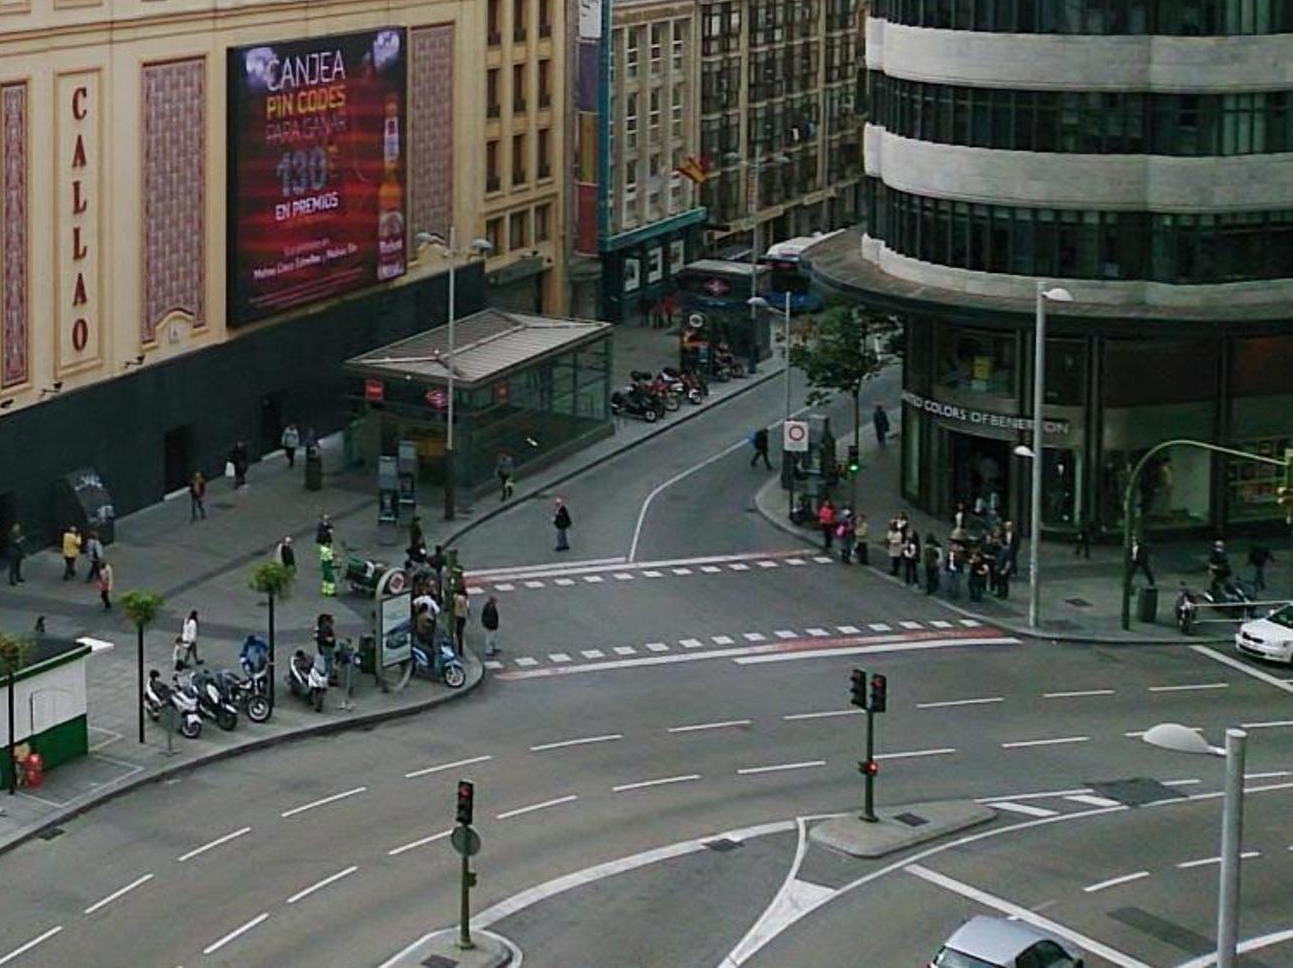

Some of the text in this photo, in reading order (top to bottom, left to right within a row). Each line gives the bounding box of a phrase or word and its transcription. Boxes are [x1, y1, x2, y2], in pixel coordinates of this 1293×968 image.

[266, 49, 346, 91] CANJEA
[266, 84, 346, 120] PIN CODES
[71, 86, 89, 352] CALLAO
[275, 191, 339, 220] EN PREMIOS
[923, 399, 967, 421] COLORS
[970, 411, 989, 424] OF
[990, 413, 1069, 434] BENETON
